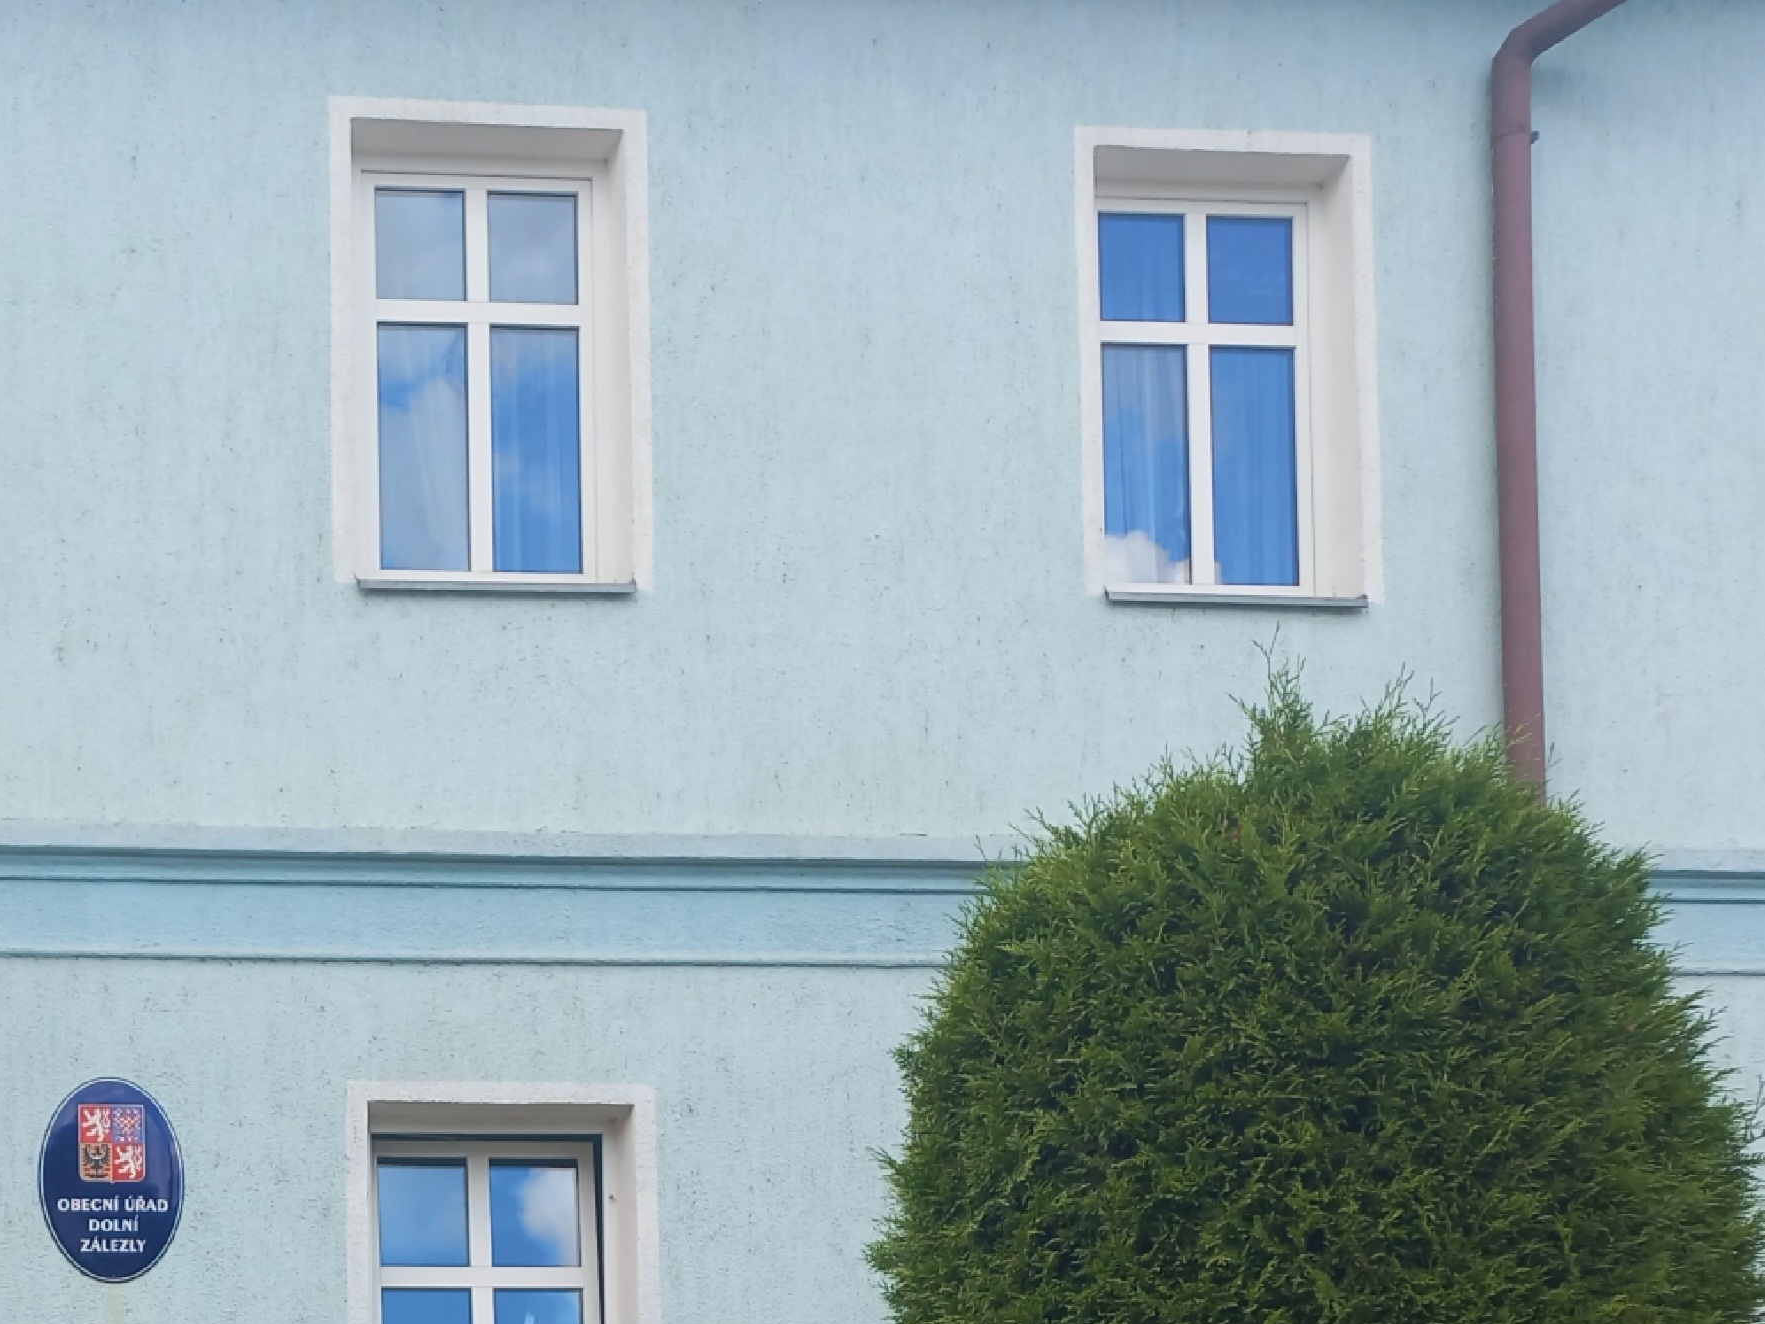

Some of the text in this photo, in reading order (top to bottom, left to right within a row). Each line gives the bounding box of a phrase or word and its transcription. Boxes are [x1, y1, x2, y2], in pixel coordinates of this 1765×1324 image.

[57, 1194, 169, 1213] OBECNÍ ÚŘAD
[88, 1214, 139, 1232] DOLNÍ
[80, 1235, 146, 1253] ZÁLEZLY
